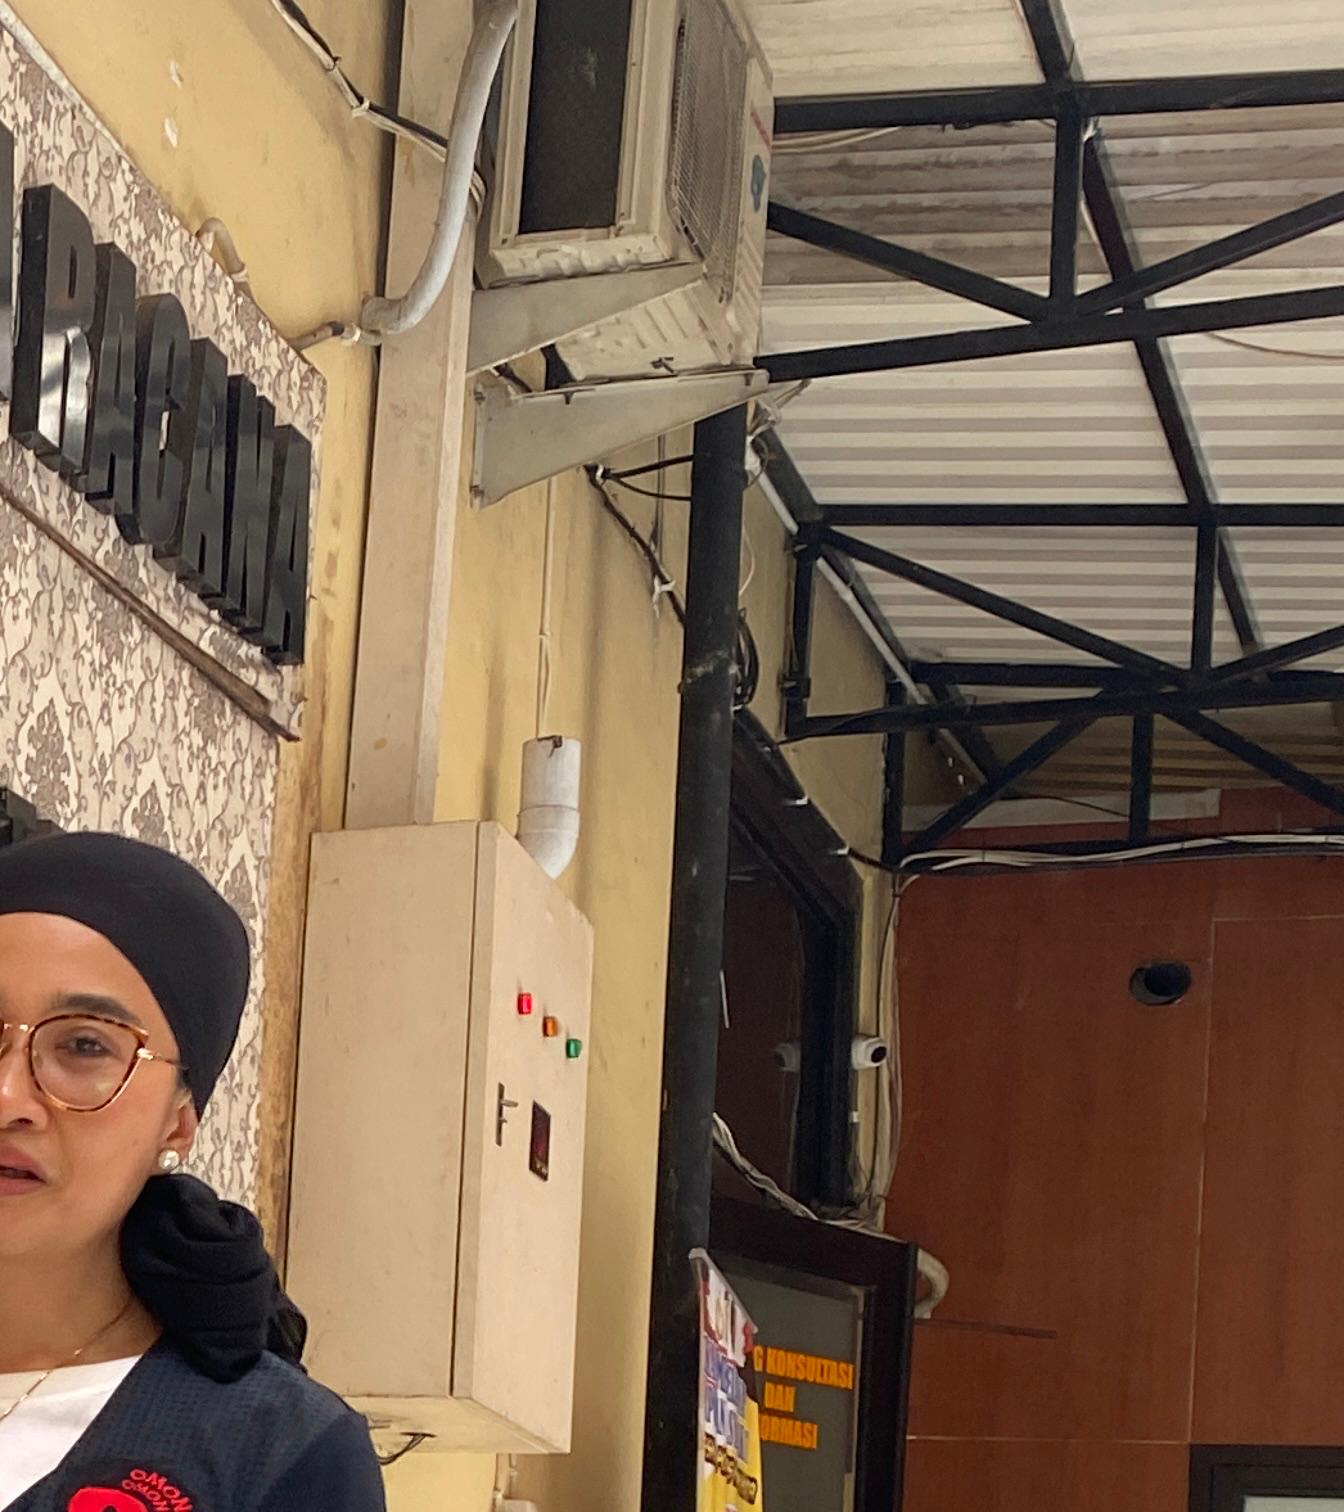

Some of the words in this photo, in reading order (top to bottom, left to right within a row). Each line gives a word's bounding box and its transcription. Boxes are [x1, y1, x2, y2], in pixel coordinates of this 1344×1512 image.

[9, 183, 312, 666] RACANA
[766, 1346, 853, 1390] KONSULTASI
[764, 1381, 796, 1413] DAN
